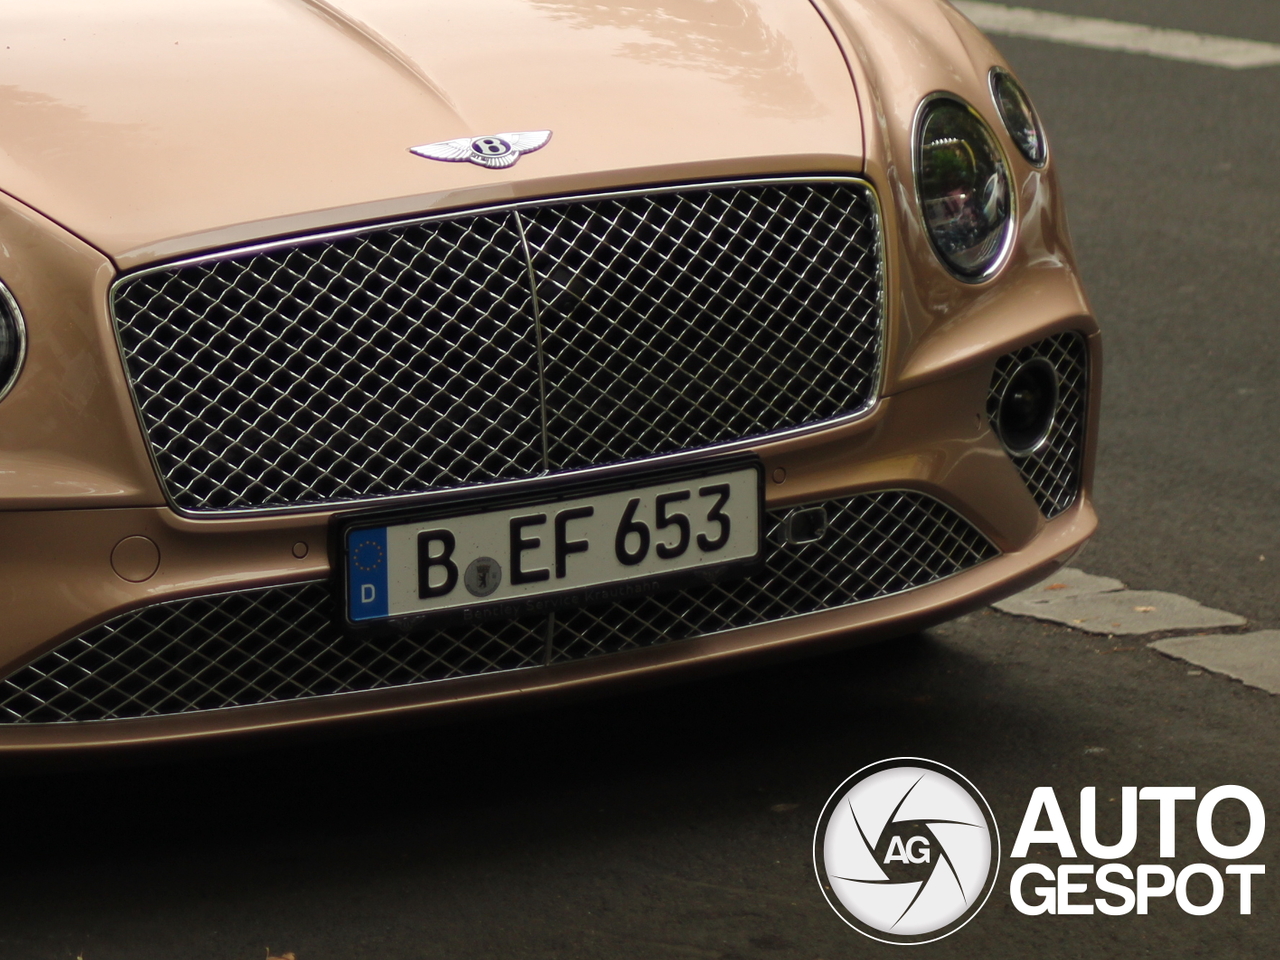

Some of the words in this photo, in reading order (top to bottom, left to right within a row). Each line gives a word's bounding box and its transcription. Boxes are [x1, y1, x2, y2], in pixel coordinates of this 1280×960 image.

[360, 583, 376, 604] D
[416, 528, 459, 600] B
[509, 506, 595, 586] EF
[614, 482, 731, 566] 653
[463, 603, 521, 621] Bentley
[526, 595, 579, 611] Service
[585, 581, 660, 602] Krauthahn
